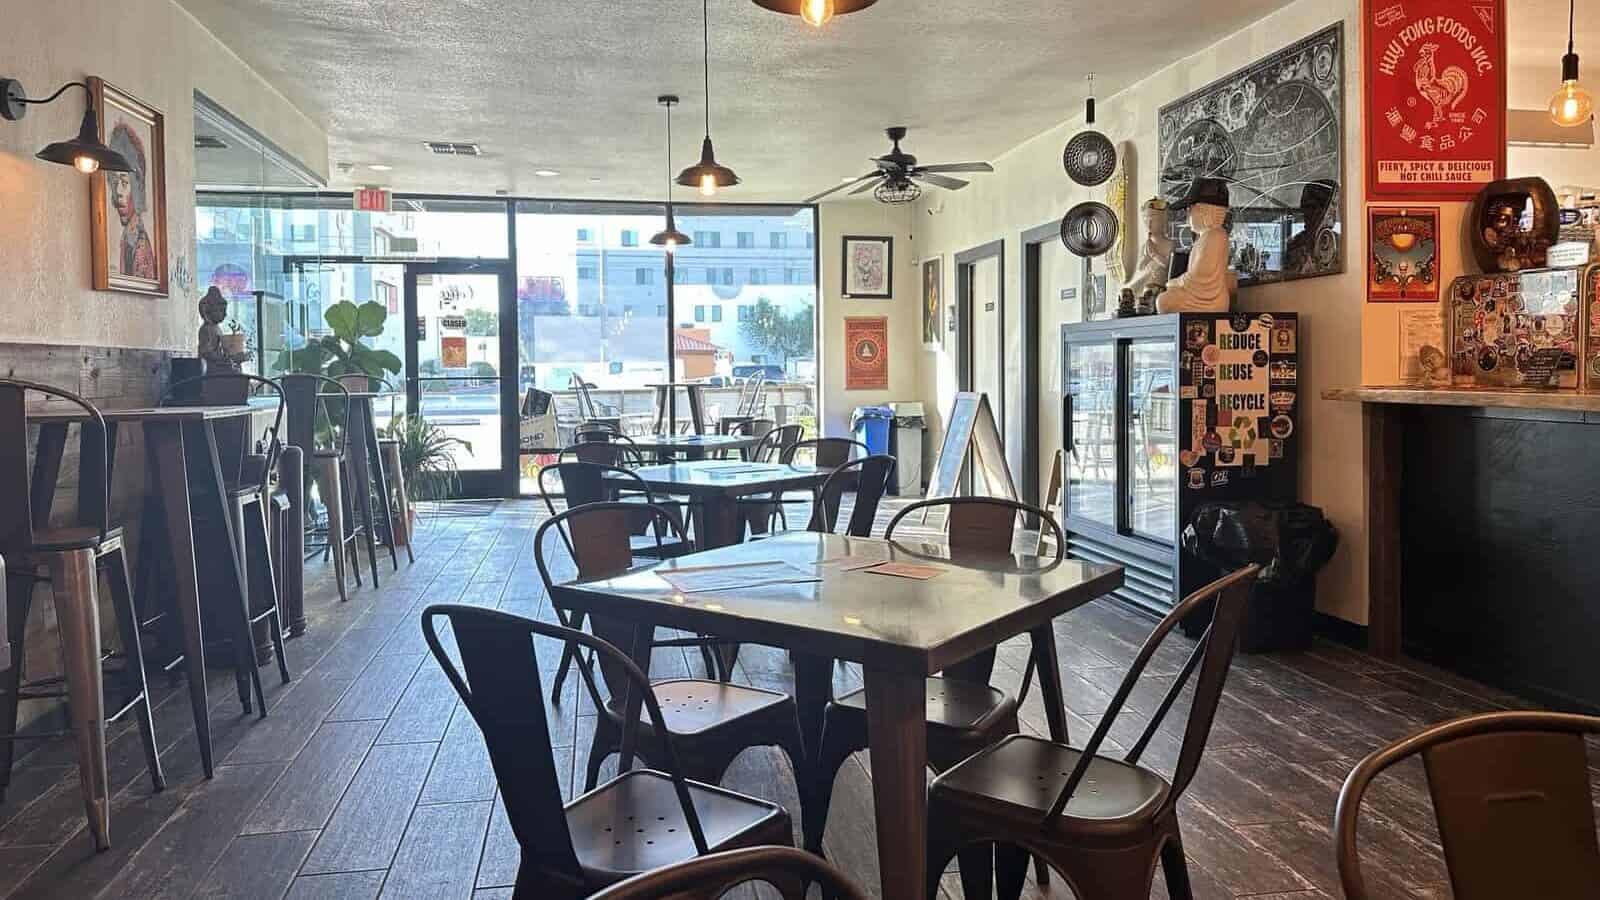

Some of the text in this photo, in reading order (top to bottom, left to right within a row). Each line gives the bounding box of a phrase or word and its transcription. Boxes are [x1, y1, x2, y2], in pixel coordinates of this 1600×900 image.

[1379, 40, 1404, 76] HUY
[1398, 17, 1434, 47] FONG
[1436, 16, 1476, 50] FOODS
[1470, 46, 1492, 76] INC.
[1380, 162, 1491, 172] FIERY, SPICY & DELICIOUS
[1400, 172, 1472, 181] HOT CHILI SAUCE
[360, 190, 384, 210] EXIT
[442, 319, 467, 328] CLOSED
[1219, 333, 1261, 350] REDUCE
[1219, 364, 1253, 380] REUSE
[1219, 393, 1265, 410] RECYCLE
